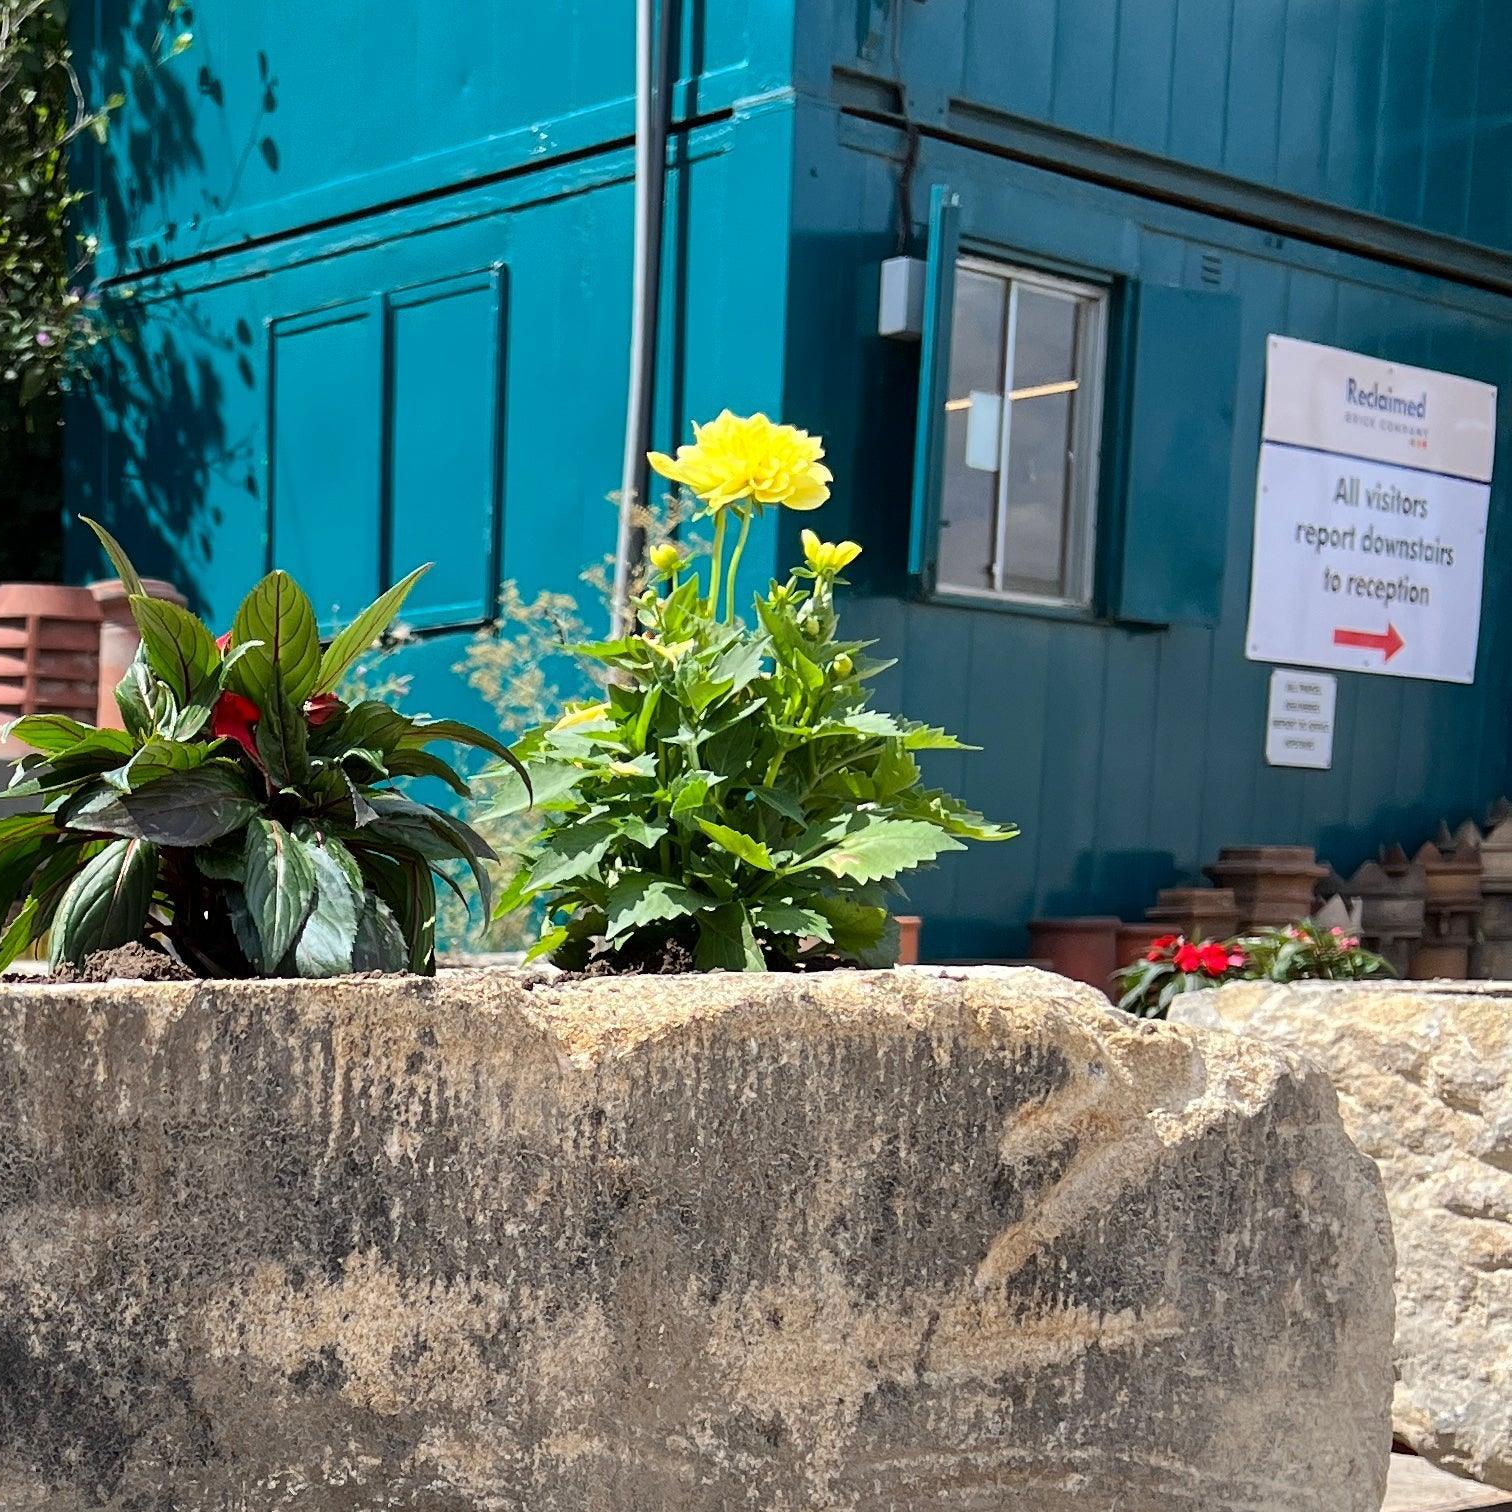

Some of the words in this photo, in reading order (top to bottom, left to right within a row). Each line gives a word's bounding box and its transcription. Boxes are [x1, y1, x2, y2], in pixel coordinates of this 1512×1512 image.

[1346, 377, 1427, 419] Reclaimed
[1334, 478, 1361, 507] All
[1365, 481, 1428, 518] visitors
[1294, 521, 1356, 554] report
[1361, 523, 1456, 567] downstairs
[1323, 566, 1341, 592] to
[1347, 574, 1430, 608] reception
